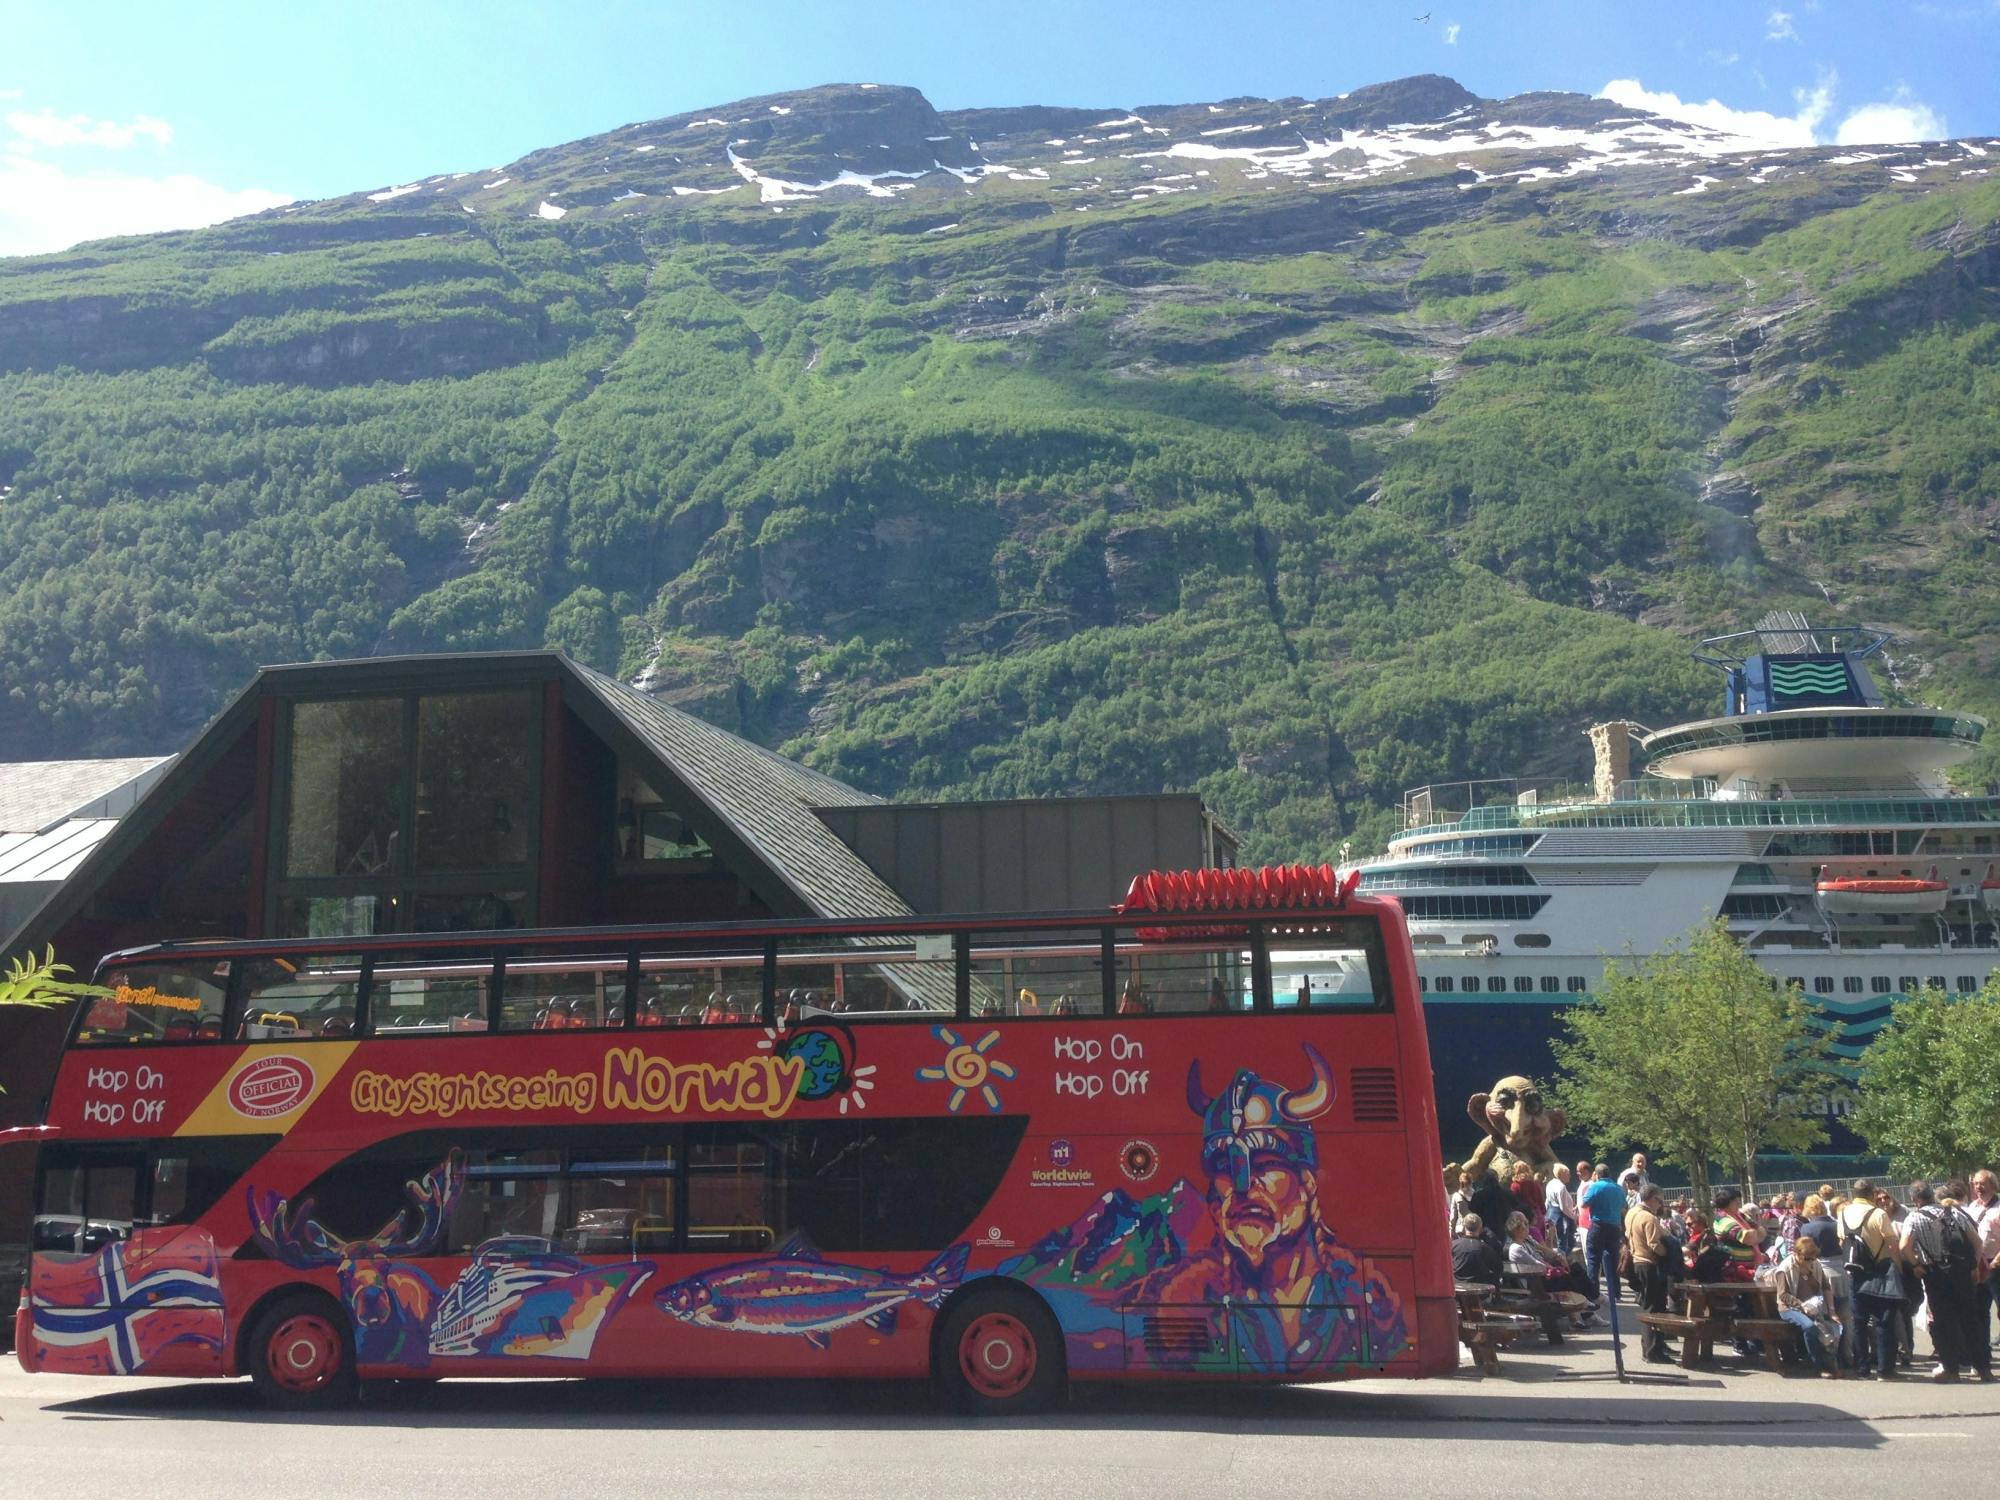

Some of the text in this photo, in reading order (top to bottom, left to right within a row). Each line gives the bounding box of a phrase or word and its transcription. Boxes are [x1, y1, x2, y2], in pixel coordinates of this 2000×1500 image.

[1054, 1033, 1143, 1064] Hop On
[87, 1065, 164, 1092] Hop On
[242, 1076, 297, 1098] OFFICIAL
[351, 1047, 805, 1118] CitySightseeing Norway
[1055, 1069, 1150, 1100] Hop Off
[84, 1098, 167, 1126] Hop Off
[260, 1097, 299, 1117] NORWAY
[1032, 1169, 1092, 1181] Worldwide
